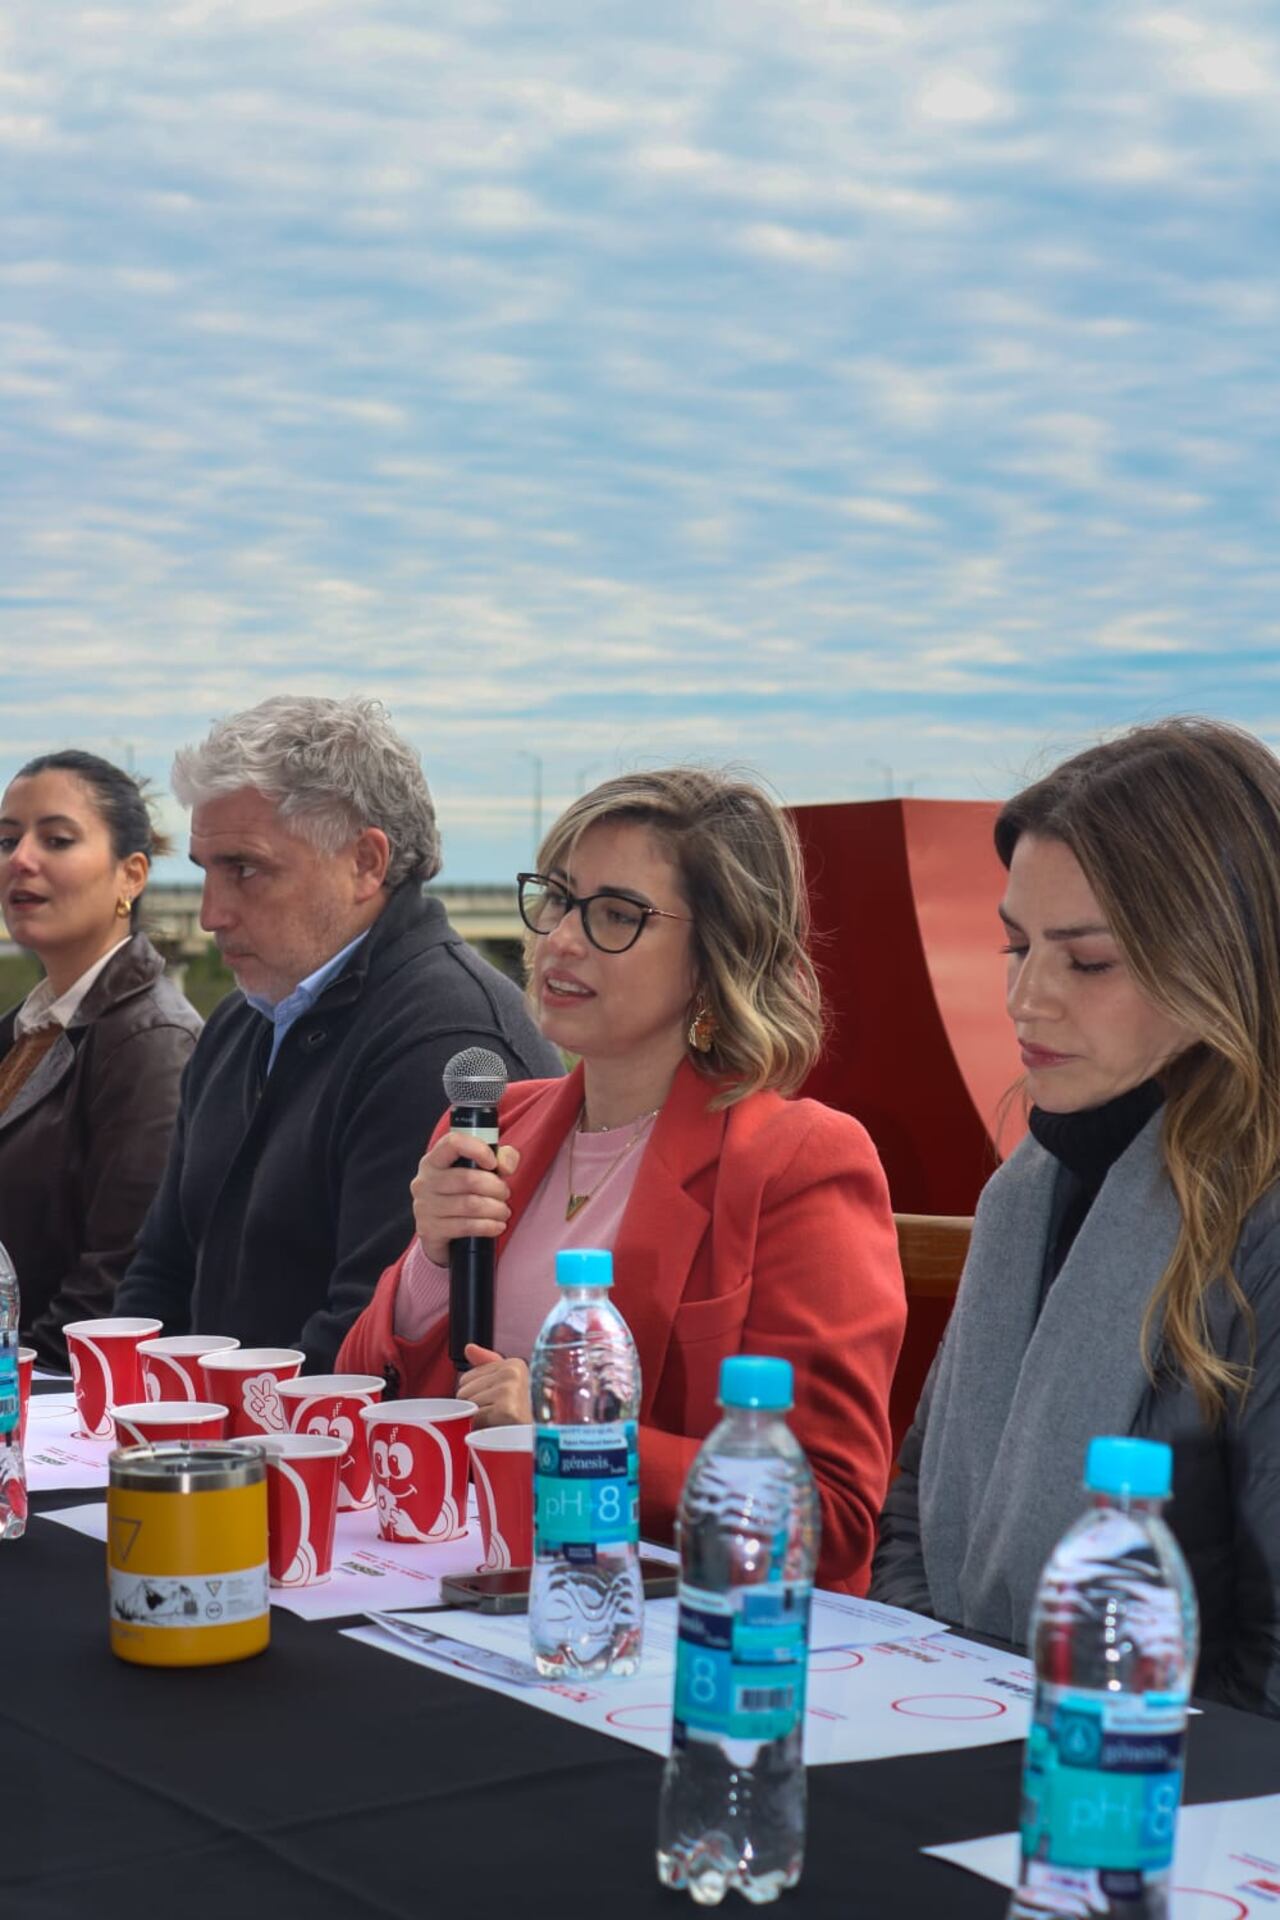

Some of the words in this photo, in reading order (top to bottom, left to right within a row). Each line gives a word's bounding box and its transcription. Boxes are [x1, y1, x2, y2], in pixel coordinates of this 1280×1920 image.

[545, 1488, 583, 1522] pH
[598, 1485, 621, 1522] 8
[691, 1656, 717, 1703] 8
[1152, 1785, 1175, 1837] 8
